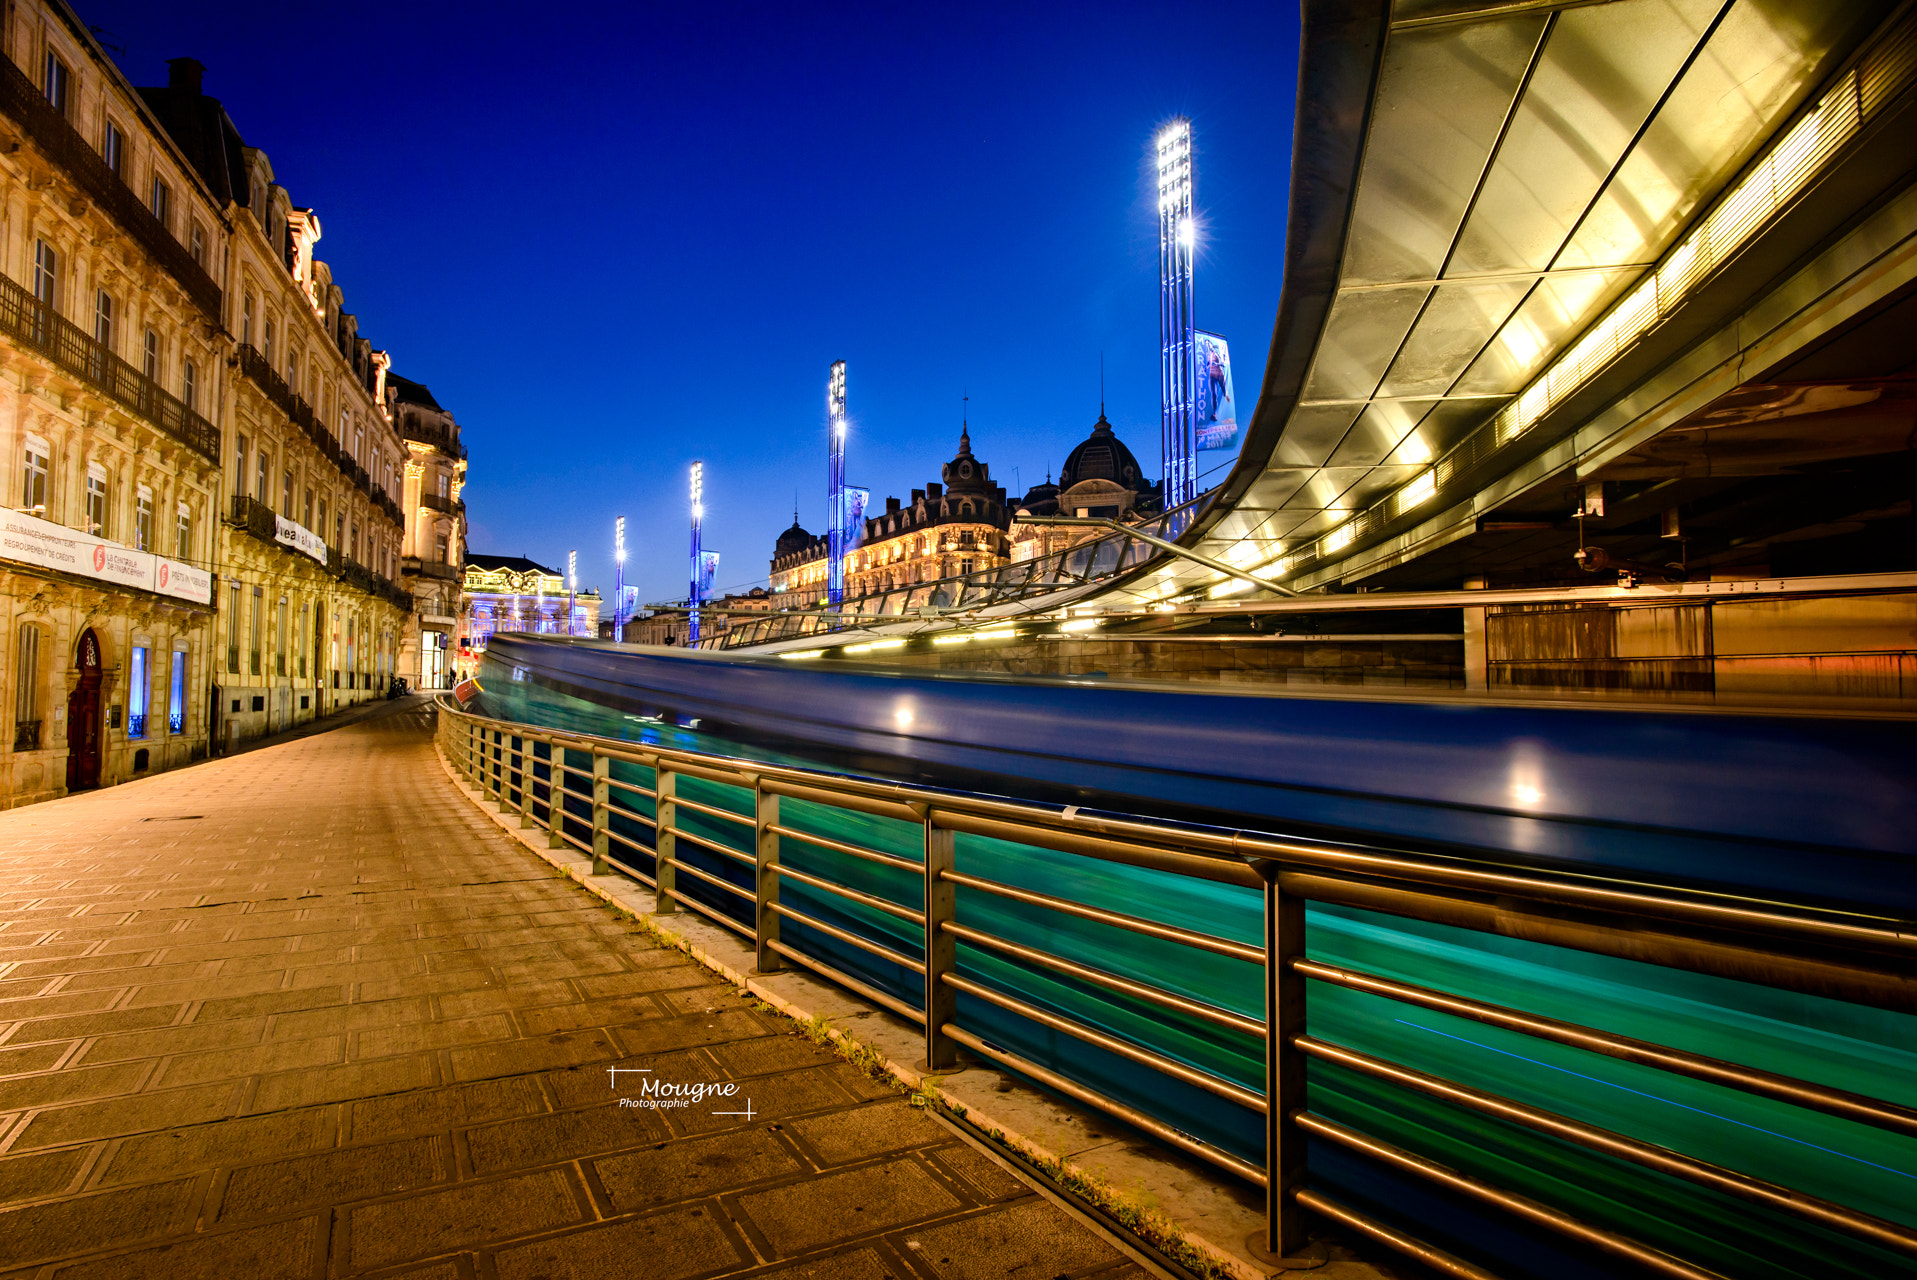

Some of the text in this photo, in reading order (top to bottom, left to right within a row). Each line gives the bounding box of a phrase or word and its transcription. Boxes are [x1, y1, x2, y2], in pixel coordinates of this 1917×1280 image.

[1197, 336, 1206, 421] MARATHON
[4, 538, 76, 563] REGROUPEMENT DE CRÉDITS
